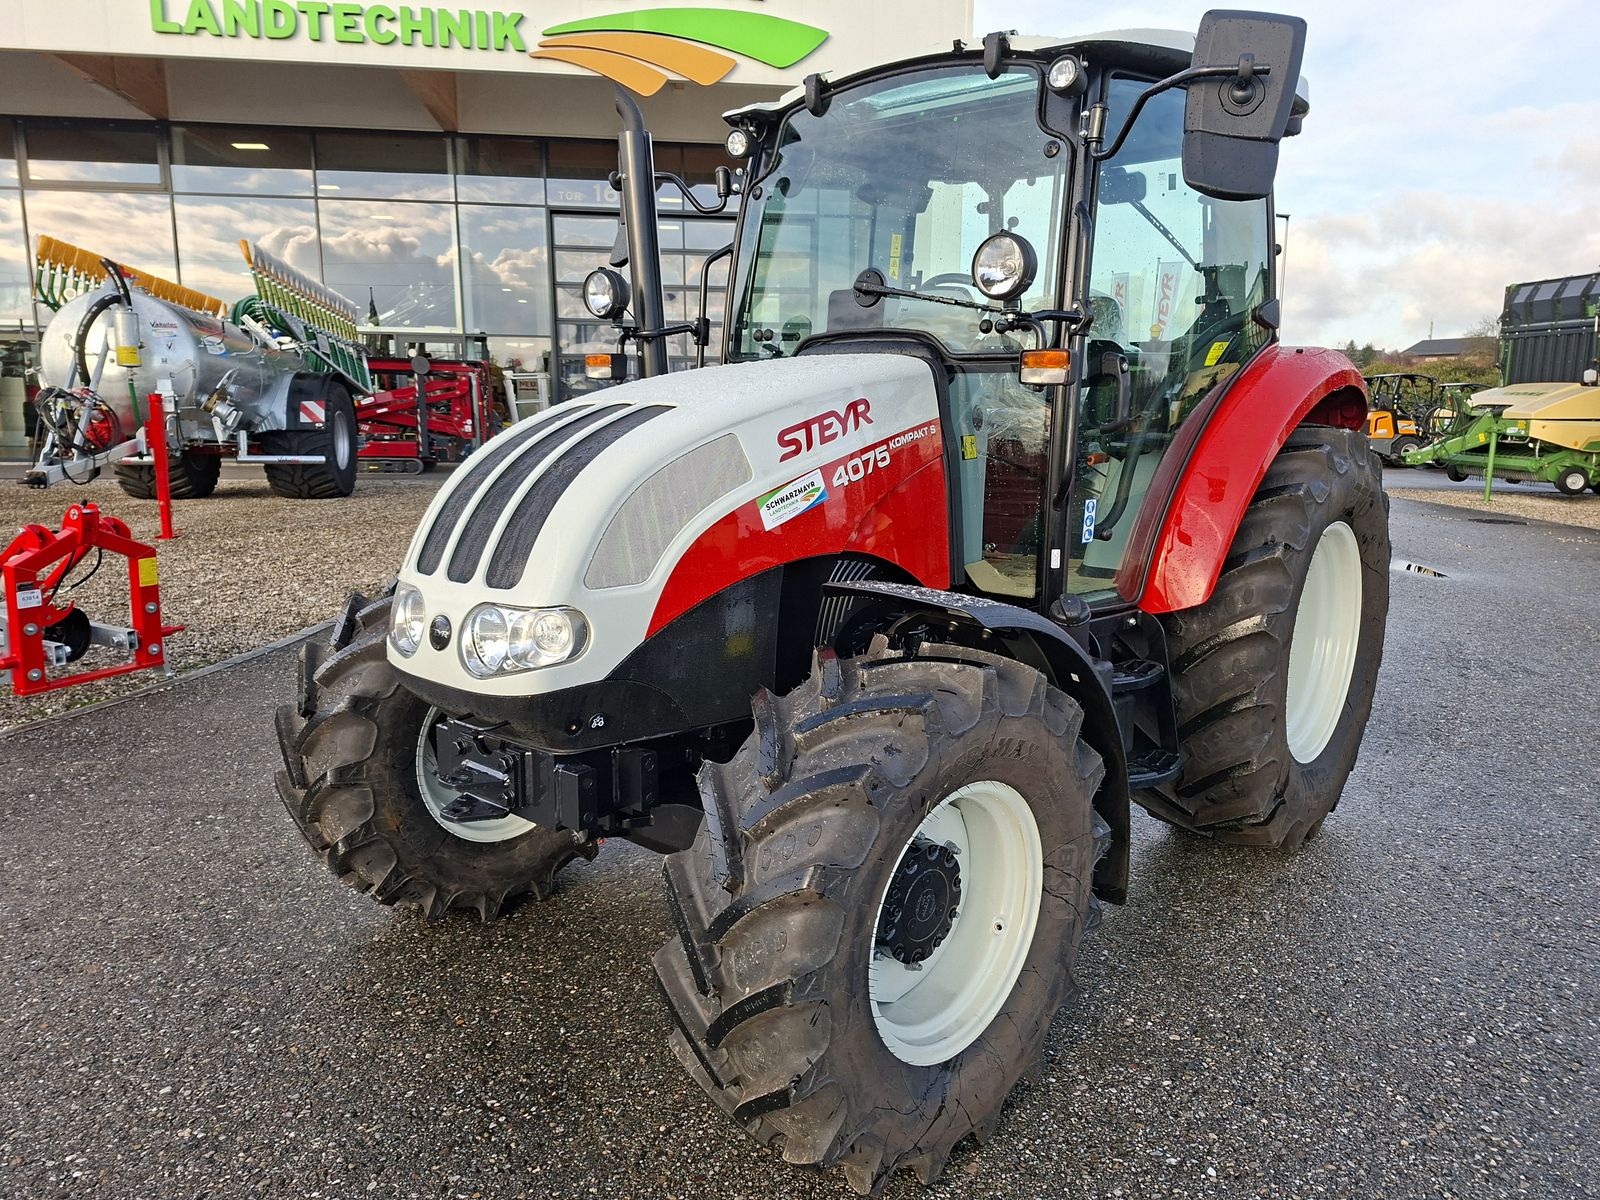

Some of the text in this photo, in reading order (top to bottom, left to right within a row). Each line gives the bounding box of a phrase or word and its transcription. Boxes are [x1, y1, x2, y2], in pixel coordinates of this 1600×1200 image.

[151, 0, 527, 51] LANDTECHNIK
[557, 183, 618, 203] TOR 16
[777, 397, 874, 464] STEYR
[832, 444, 891, 488] 4075
[888, 428, 929, 450] KOMPAKT
[929, 425, 937, 435] S
[765, 480, 816, 511] SCHWARZMAYR
[769, 499, 800, 517] LANDTECHNIK
